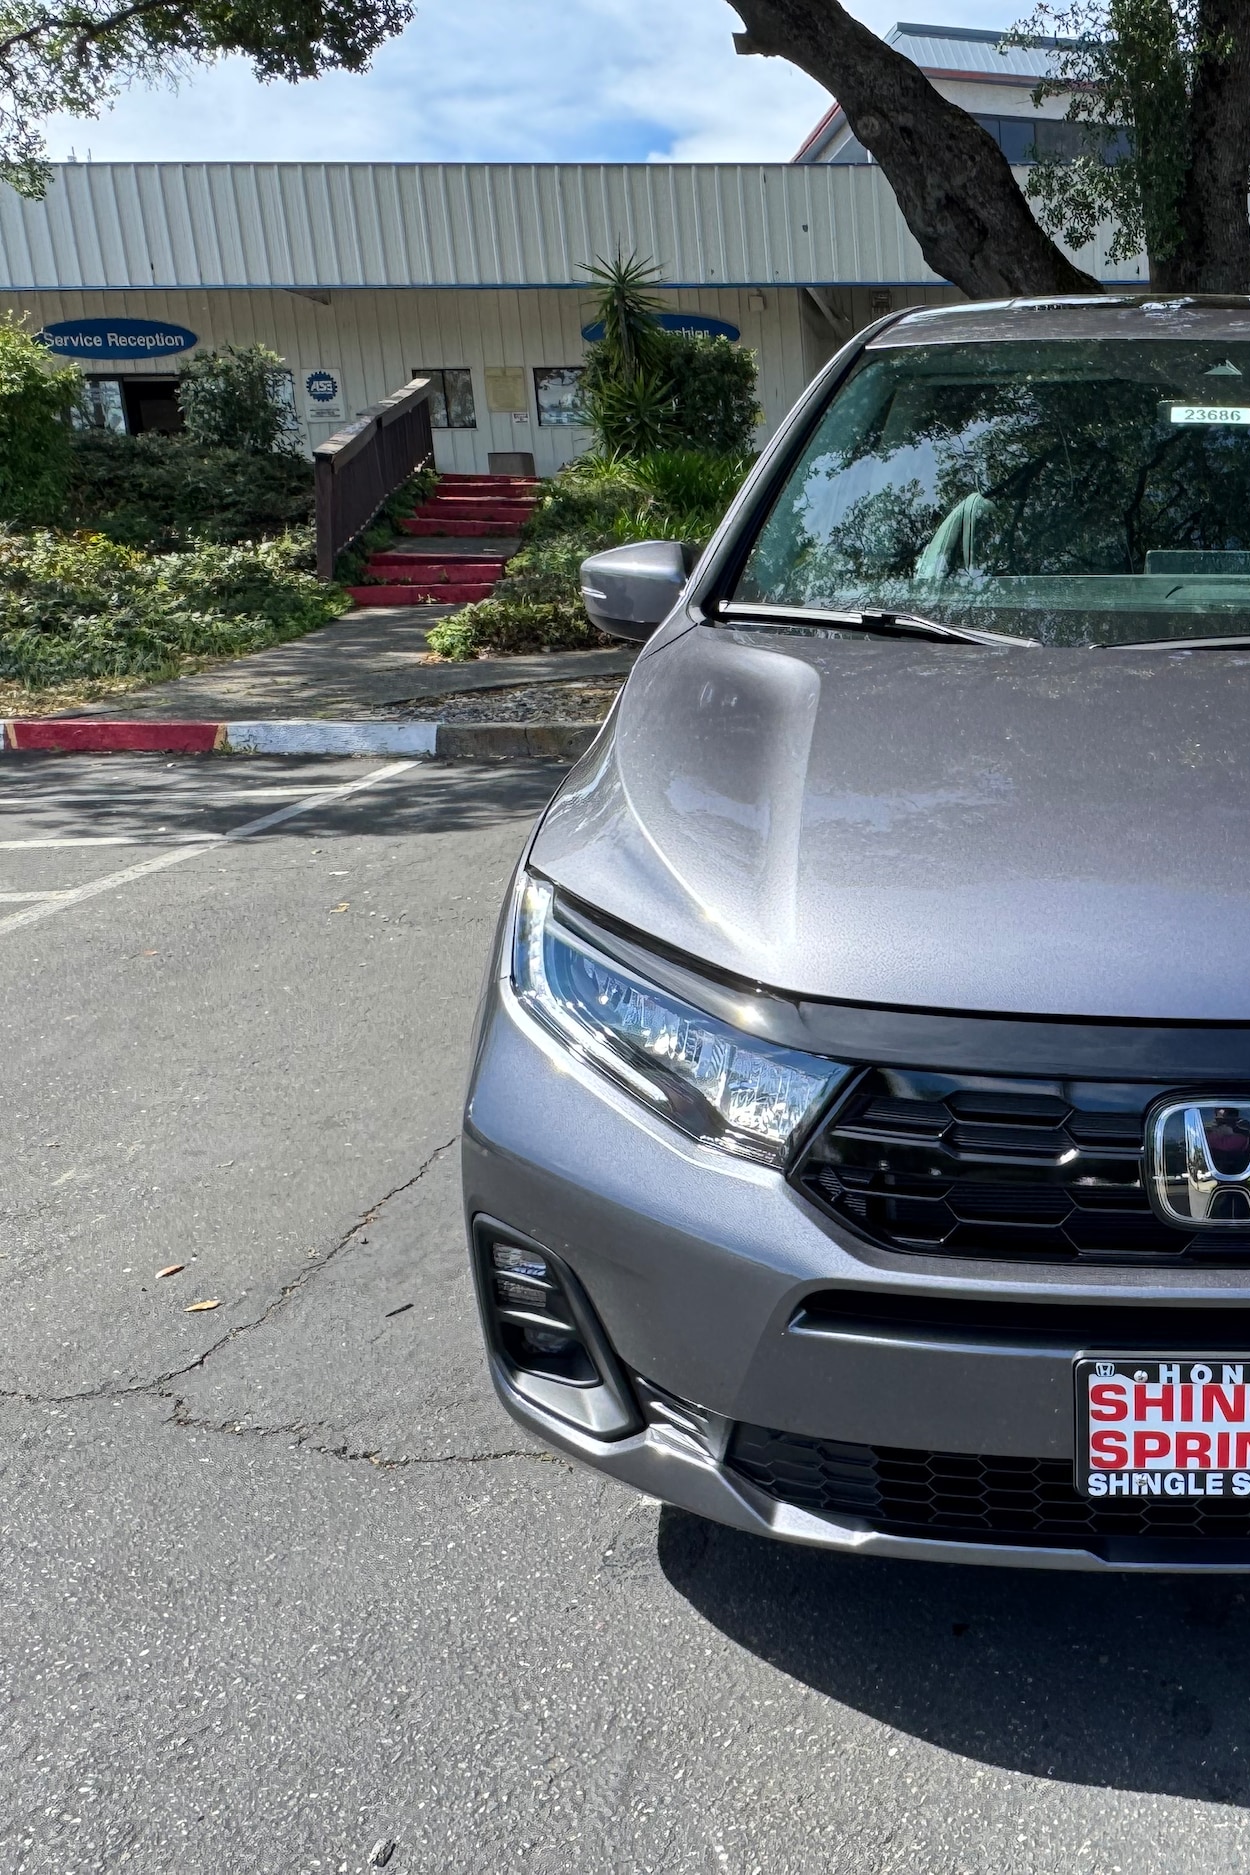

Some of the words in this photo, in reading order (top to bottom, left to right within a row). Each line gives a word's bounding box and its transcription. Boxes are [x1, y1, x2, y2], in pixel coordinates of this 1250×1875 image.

[43, 332, 103, 347] Service
[107, 332, 185, 350] Reception
[1185, 409, 1241, 421] 23686
[1087, 1472, 1224, 1497] SHINGLE
